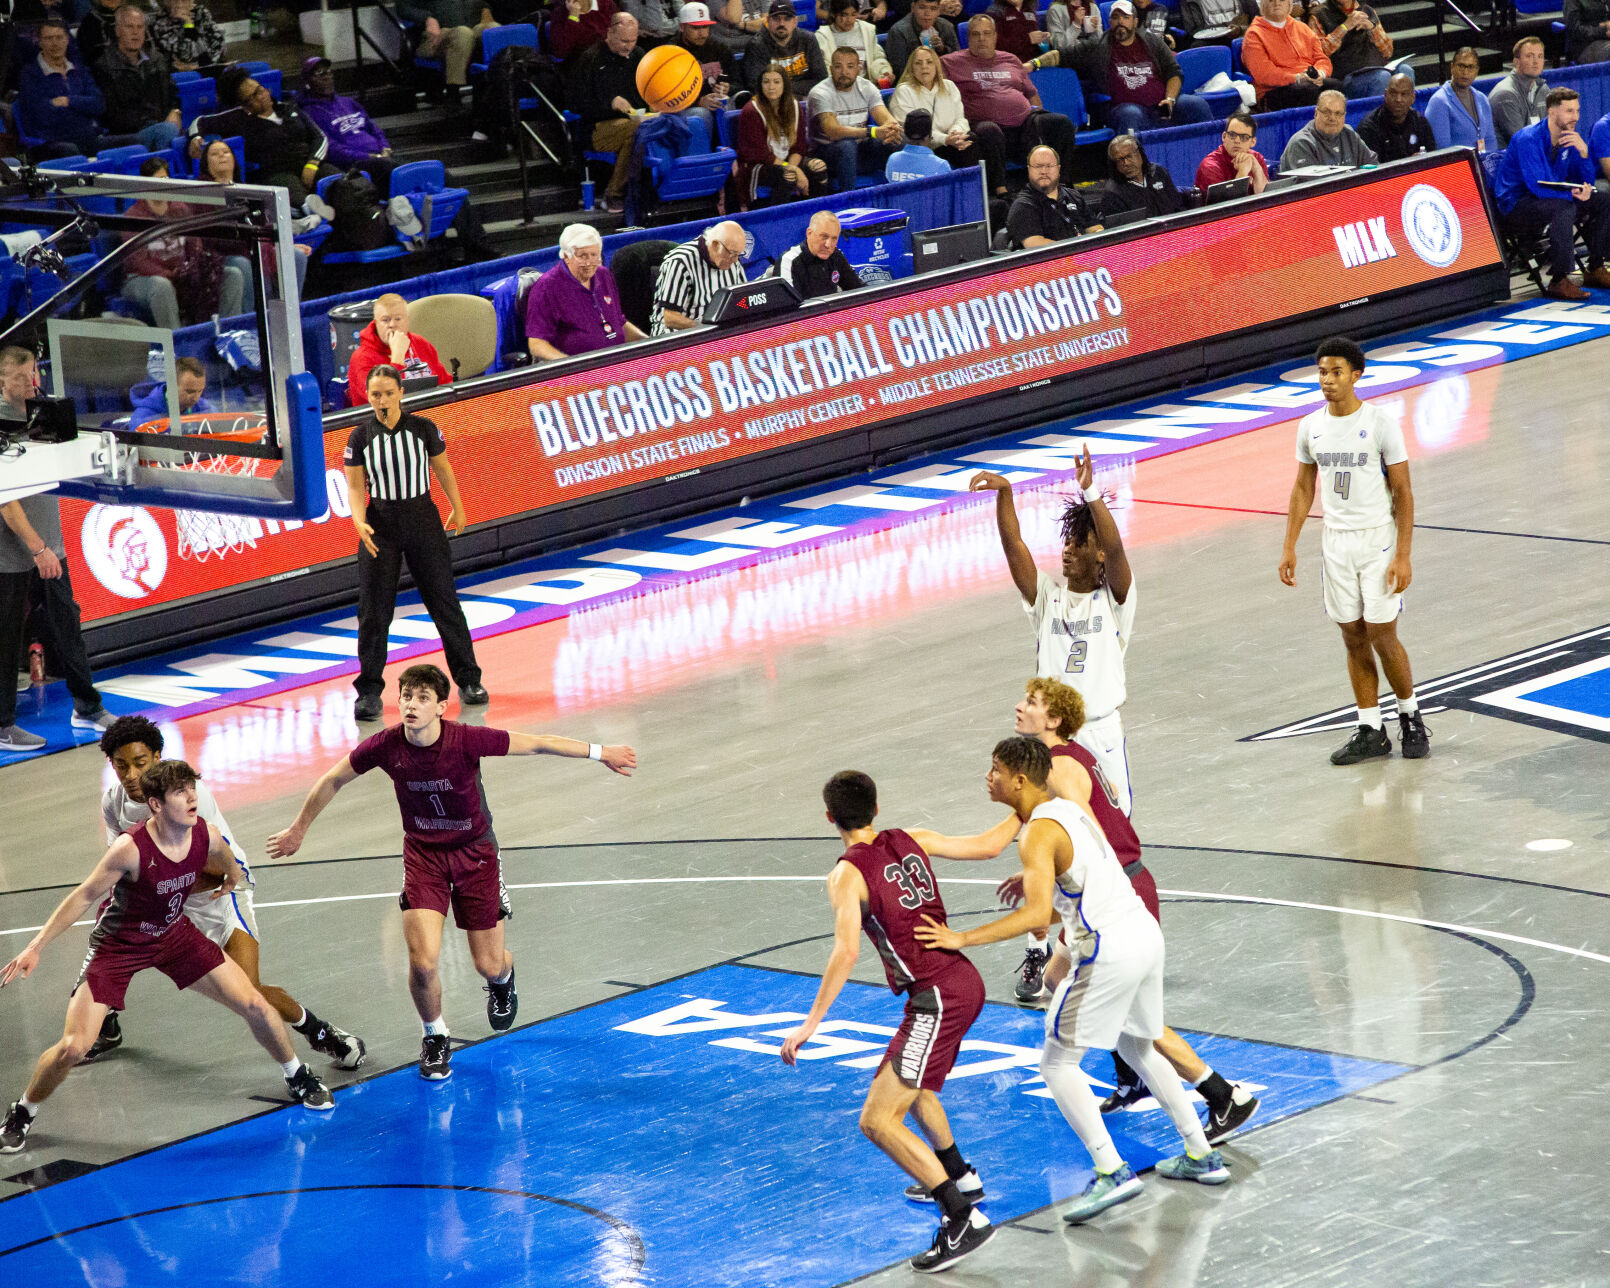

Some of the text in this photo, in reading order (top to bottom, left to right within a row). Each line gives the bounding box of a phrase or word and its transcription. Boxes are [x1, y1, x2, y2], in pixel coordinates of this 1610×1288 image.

[664, 75, 700, 108] Wilson
[1332, 215, 1399, 269] MLK
[748, 292, 768, 307] POSS
[530, 266, 1123, 457] BLUECROSS BASKETBALL CHAMPIONSHIPS
[554, 455, 623, 488] DIVISION
[631, 441, 678, 469] STATE
[677, 427, 731, 457] FINALS
[743, 408, 807, 440] MURPHY
[806, 393, 867, 423] CENTER
[878, 376, 934, 405] MIDDLE
[933, 357, 1013, 393] TENNESSEE
[1012, 347, 1055, 372] STATE
[1055, 327, 1130, 362] UNIVERSITY
[665, 468, 701, 482] DAKTRONICS
[1333, 471, 1352, 501] 4
[1064, 640, 1088, 674] 2
[406, 778, 454, 792] SPARTA
[429, 794, 446, 817] 1
[156, 871, 196, 895] SPARTA
[883, 852, 936, 911] 33
[165, 892, 183, 924] 3
[900, 1012, 936, 1081] WARRIORS
